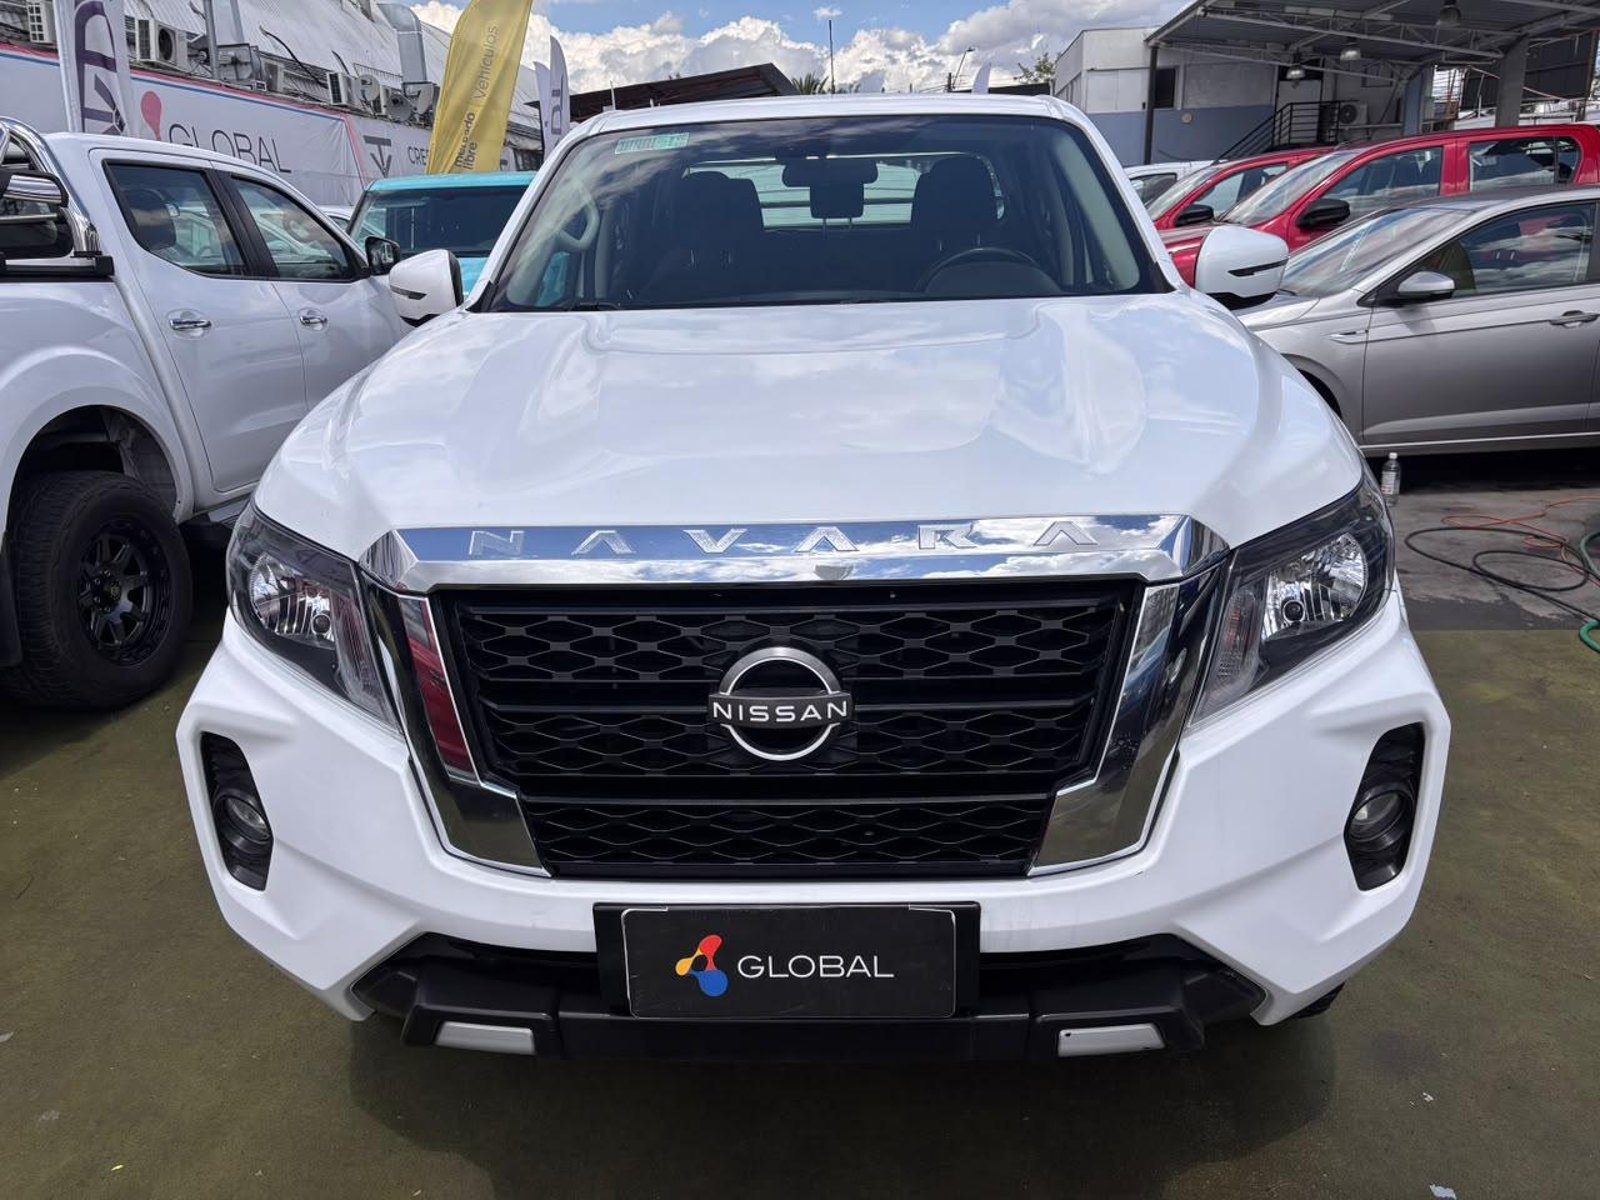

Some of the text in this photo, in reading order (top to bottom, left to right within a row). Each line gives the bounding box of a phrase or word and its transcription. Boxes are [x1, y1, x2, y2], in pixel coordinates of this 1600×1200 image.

[463, 142, 478, 170] libre
[468, 521, 1099, 557] NAVARA
[713, 701, 847, 722] NISSAN
[737, 955, 895, 979] GLOBAL
